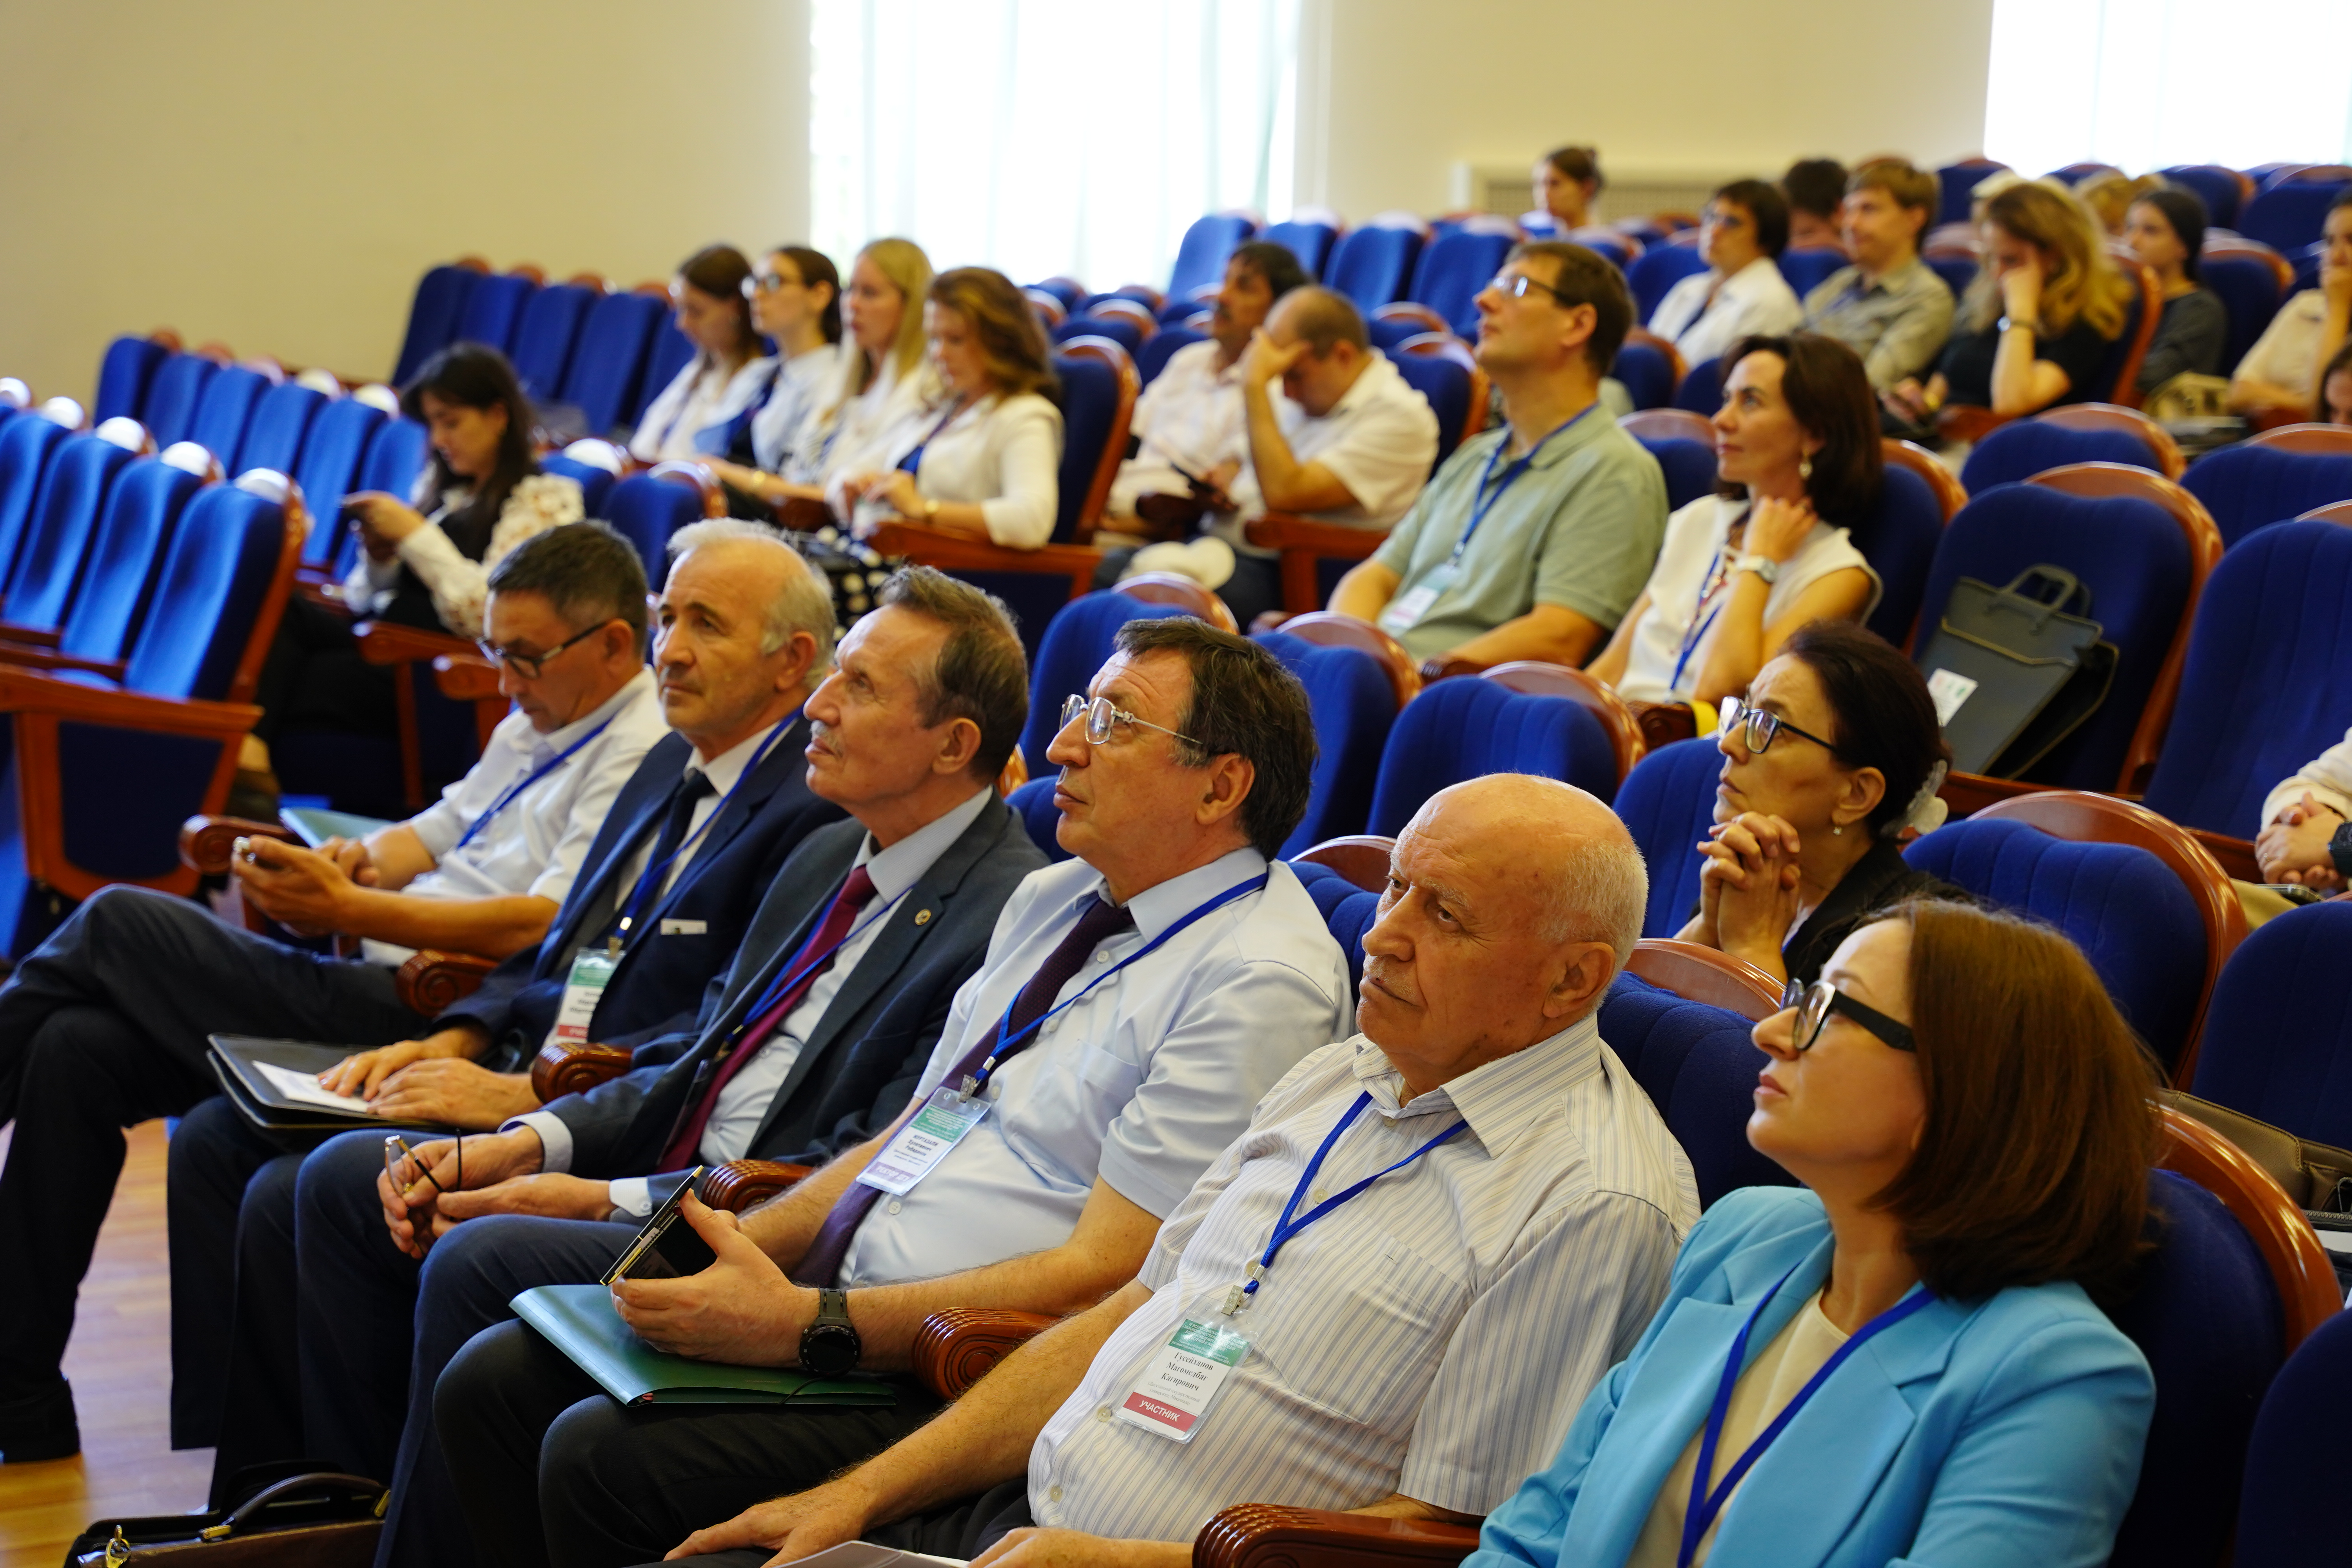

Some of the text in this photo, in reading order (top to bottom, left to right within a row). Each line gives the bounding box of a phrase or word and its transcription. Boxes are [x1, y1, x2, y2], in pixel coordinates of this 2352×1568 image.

[876, 1166, 899, 1178] РЕКТОР
[1174, 1352, 1213, 1370] Гусейханов
[1166, 1362, 1208, 1381] Магомедбаг
[1161, 1373, 1199, 1390] Кагирович
[1139, 1400, 1180, 1421] УЧАСТНИК
